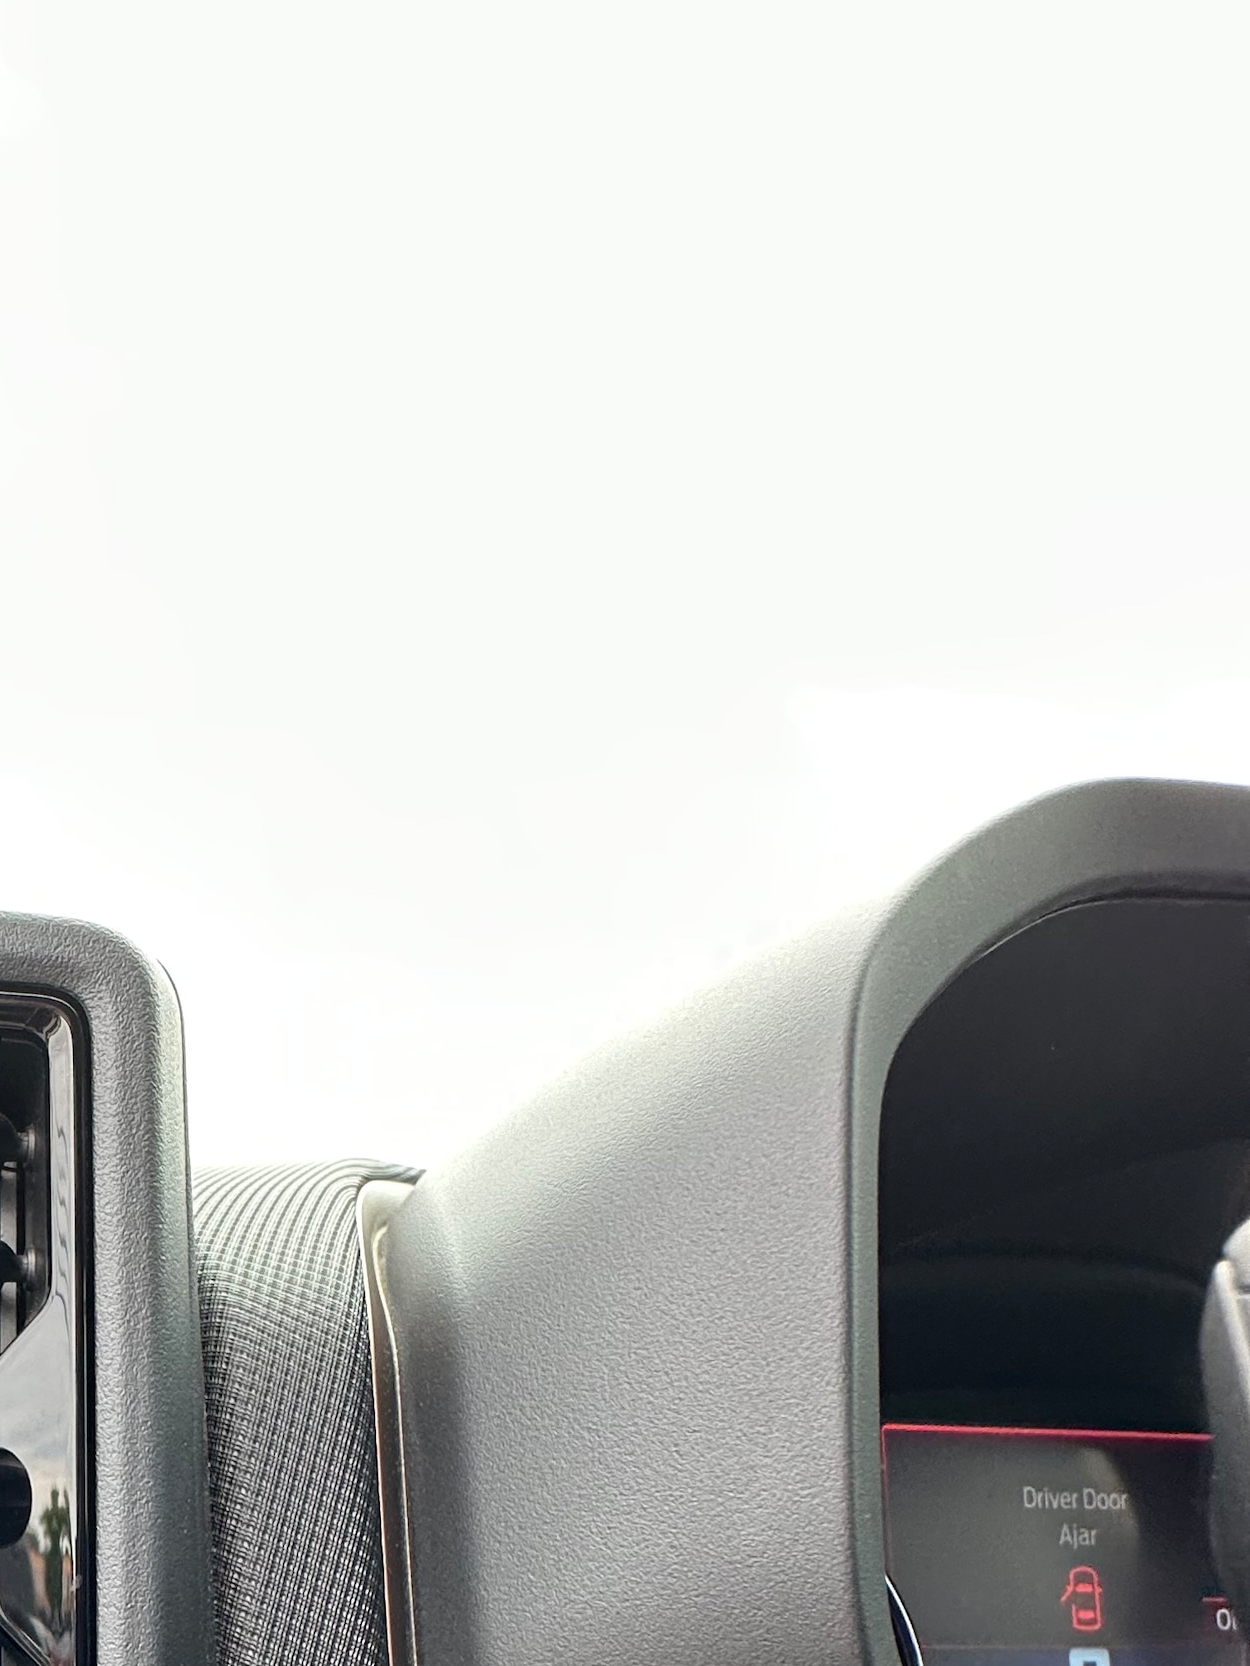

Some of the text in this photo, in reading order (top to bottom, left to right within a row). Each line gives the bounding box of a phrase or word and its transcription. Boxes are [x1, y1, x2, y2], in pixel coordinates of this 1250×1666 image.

[1023, 1486, 1128, 1510] Driver Door
[1058, 1522, 1097, 1550] Ajar
